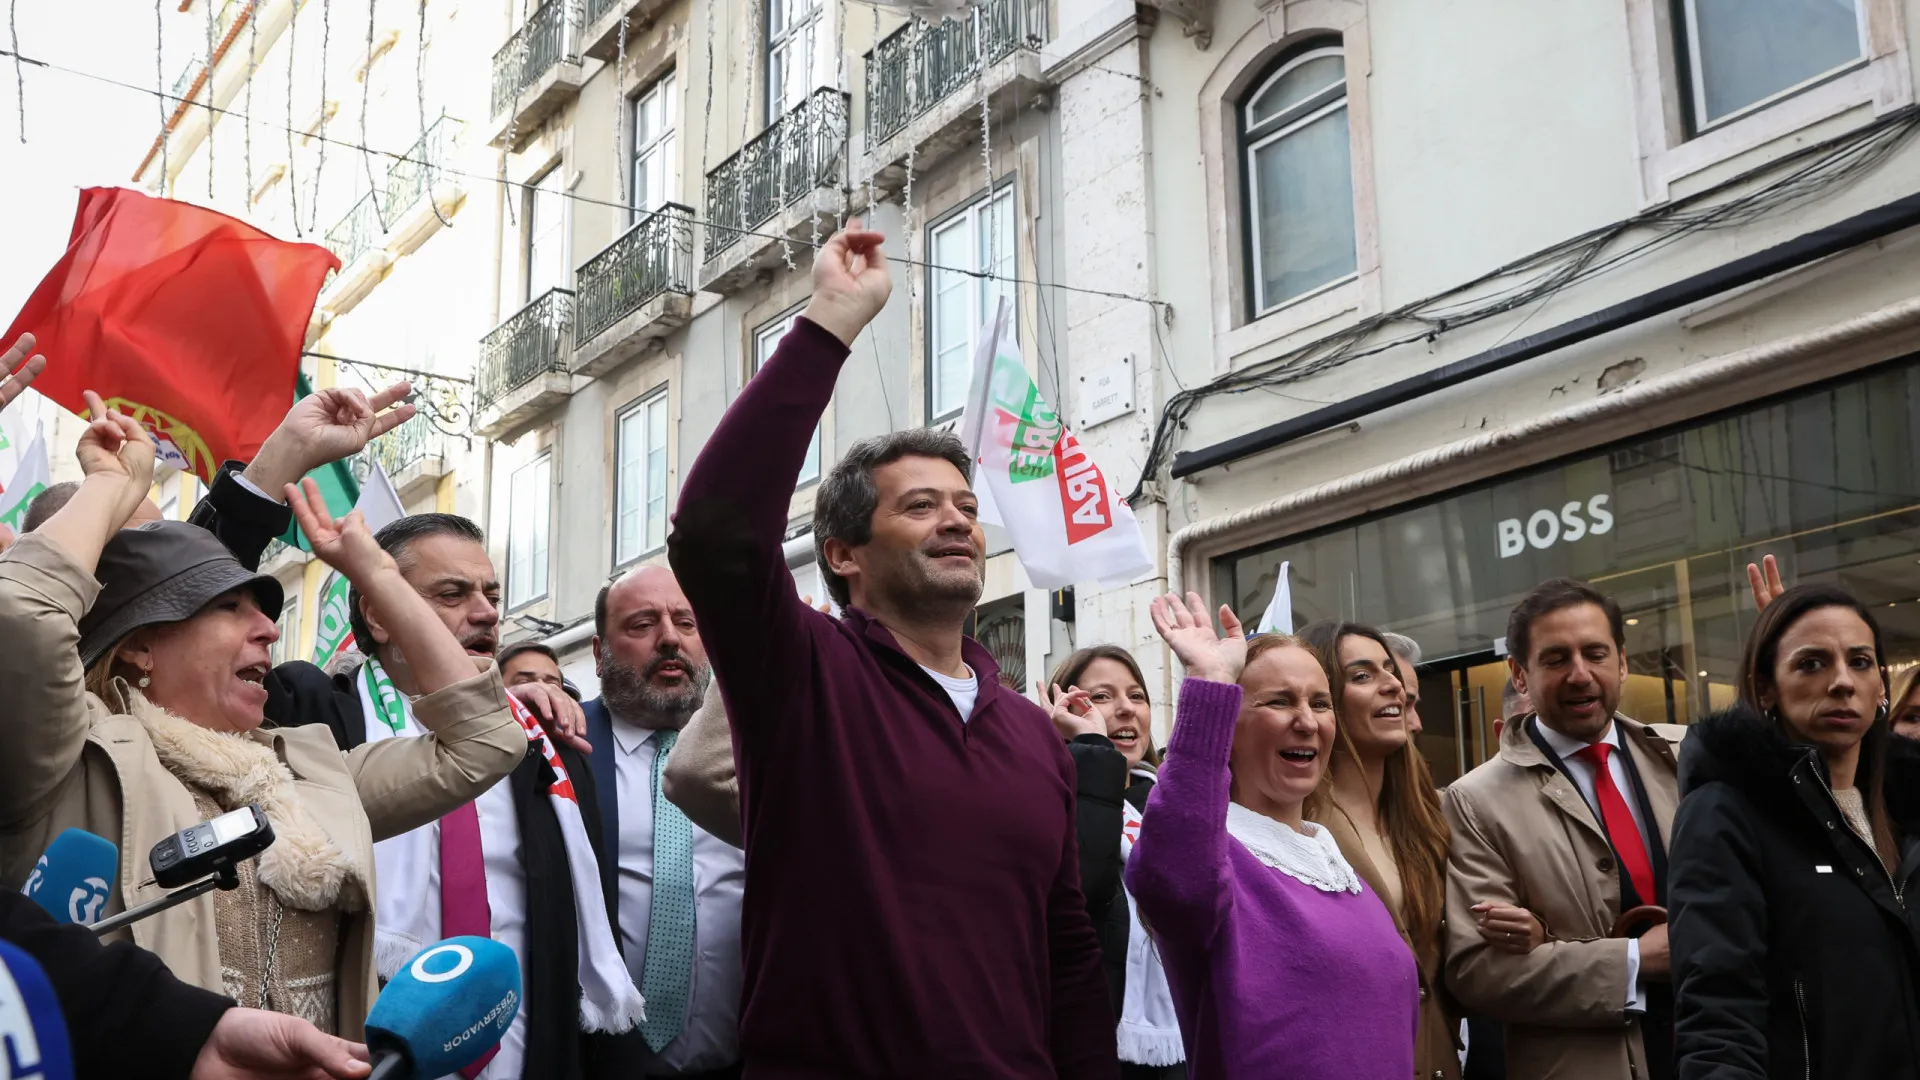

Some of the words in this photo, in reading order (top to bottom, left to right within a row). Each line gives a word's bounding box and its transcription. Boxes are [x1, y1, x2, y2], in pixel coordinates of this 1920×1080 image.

[1092, 392, 1118, 410] GARRETT
[1098, 376, 1111, 387] RUA
[1497, 494, 1614, 559] BOSS
[443, 989, 515, 1052] OBSERVADOR
